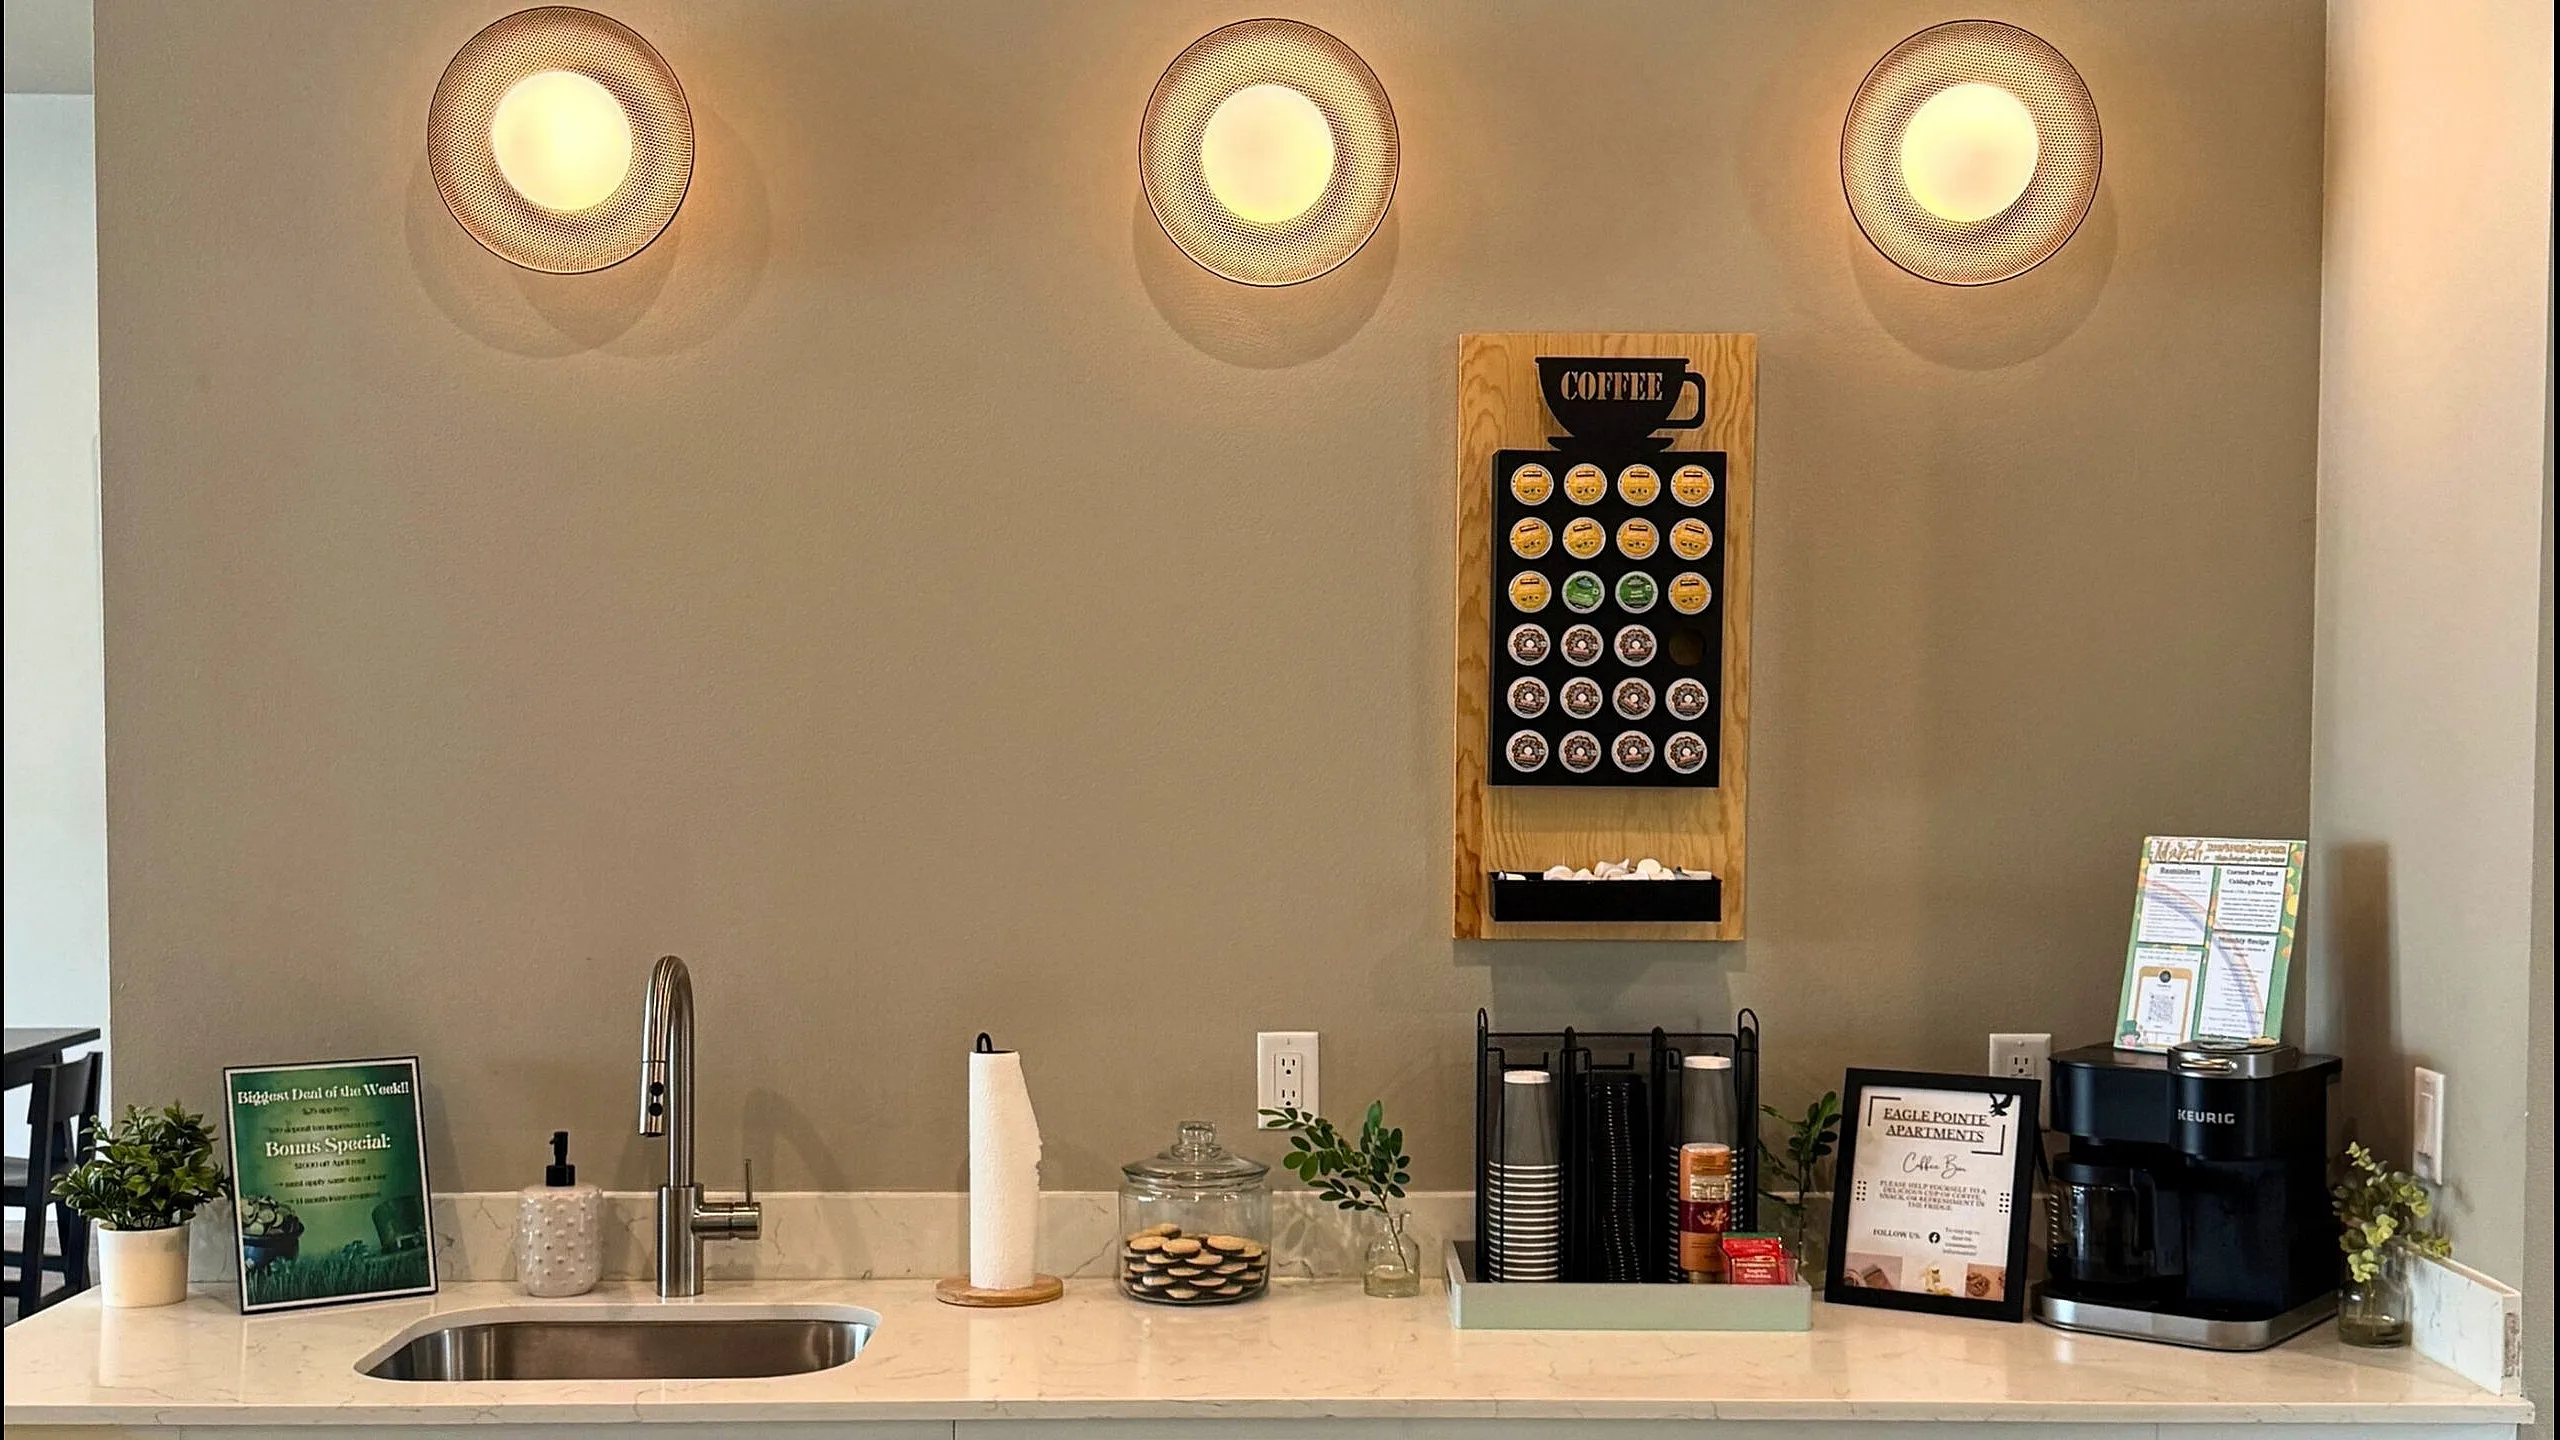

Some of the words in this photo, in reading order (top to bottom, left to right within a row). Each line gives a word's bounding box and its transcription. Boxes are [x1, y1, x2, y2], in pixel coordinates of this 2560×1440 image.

[1561, 371, 1663, 401] COFFEE
[237, 1090, 290, 1107] Biggest
[292, 1087, 323, 1101] Deal
[325, 1085, 338, 1099] of
[340, 1084, 361, 1098] the
[1884, 1108, 1931, 1123] EAGLE
[1933, 1112, 1989, 1127] POINTE
[2178, 1109, 2235, 1124] KEURIG
[1886, 1125, 1985, 1143] APARTMENTS
[265, 1141, 322, 1158] Bonus
[324, 1133, 392, 1156] Special:
[1902, 1152, 1941, 1174] Coffee
[1880, 1180, 1907, 1188] PLEASE
[1930, 1183, 1967, 1192] YOURSELF
[1883, 1186, 1923, 1196] DELICIOUS
[1918, 1196, 1974, 1207] REFRESHMENT
[1873, 1228, 1908, 1239] FOLLOW
